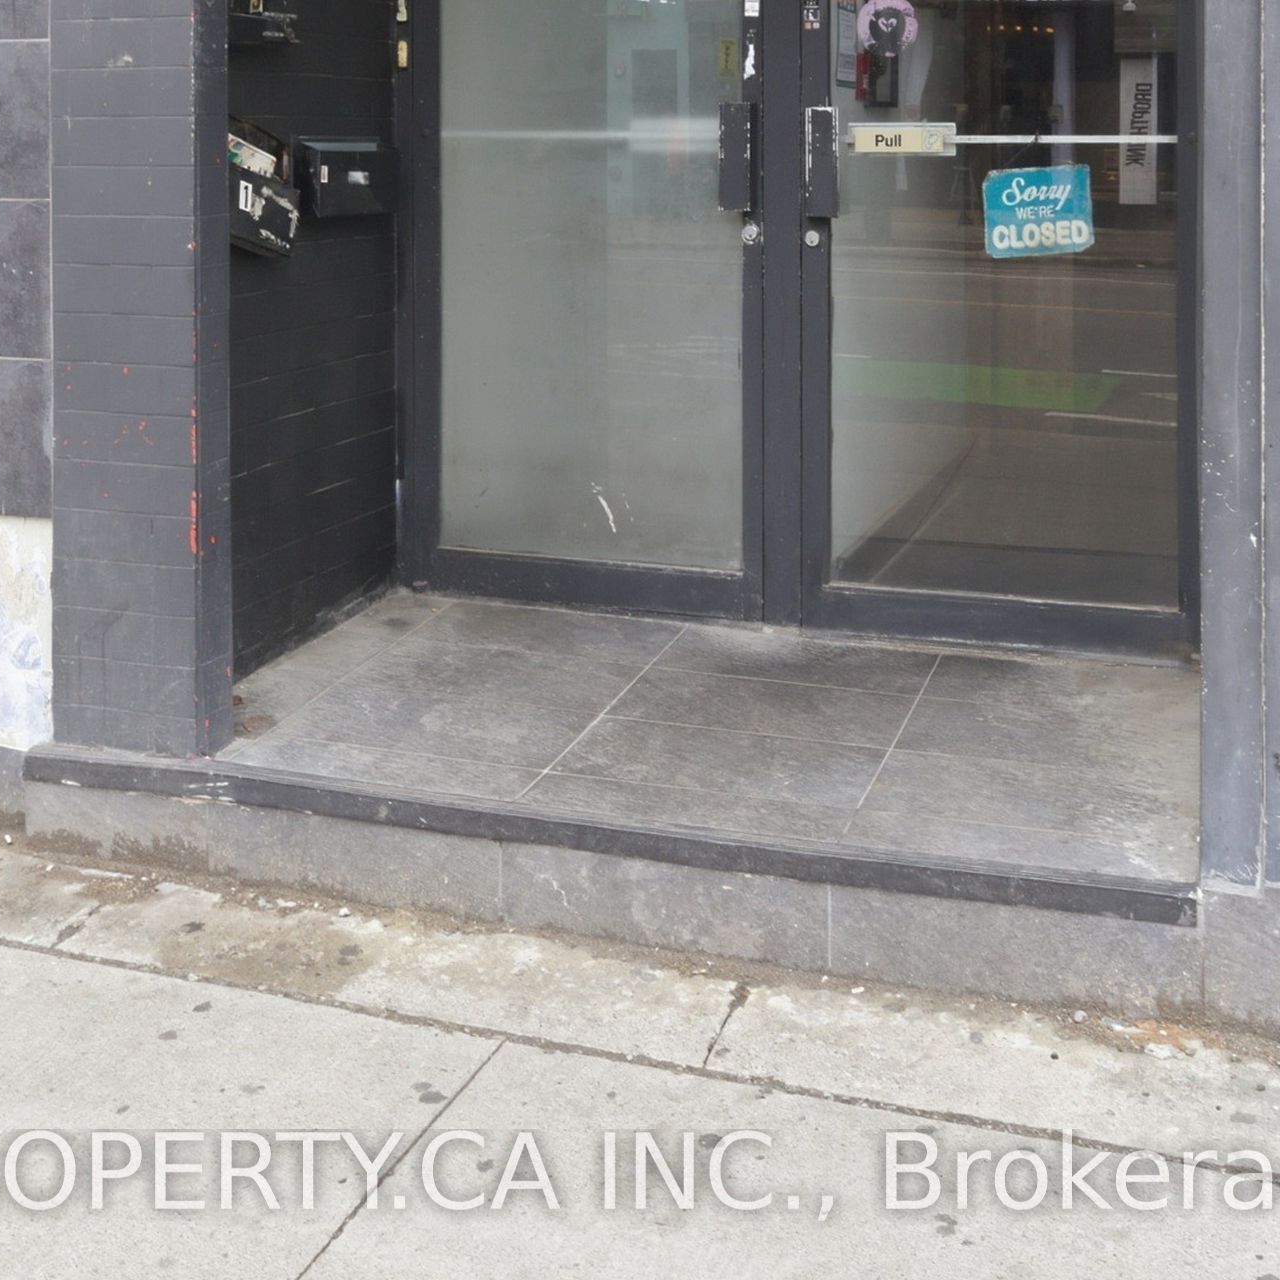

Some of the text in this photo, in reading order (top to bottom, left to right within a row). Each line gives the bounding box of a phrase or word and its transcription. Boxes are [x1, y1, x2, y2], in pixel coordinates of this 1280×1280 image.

[874, 133, 903, 149] Pull
[1001, 176, 1074, 211] Sorry
[1015, 205, 1056, 219] WE'RE
[991, 219, 1091, 250] CLOSED
